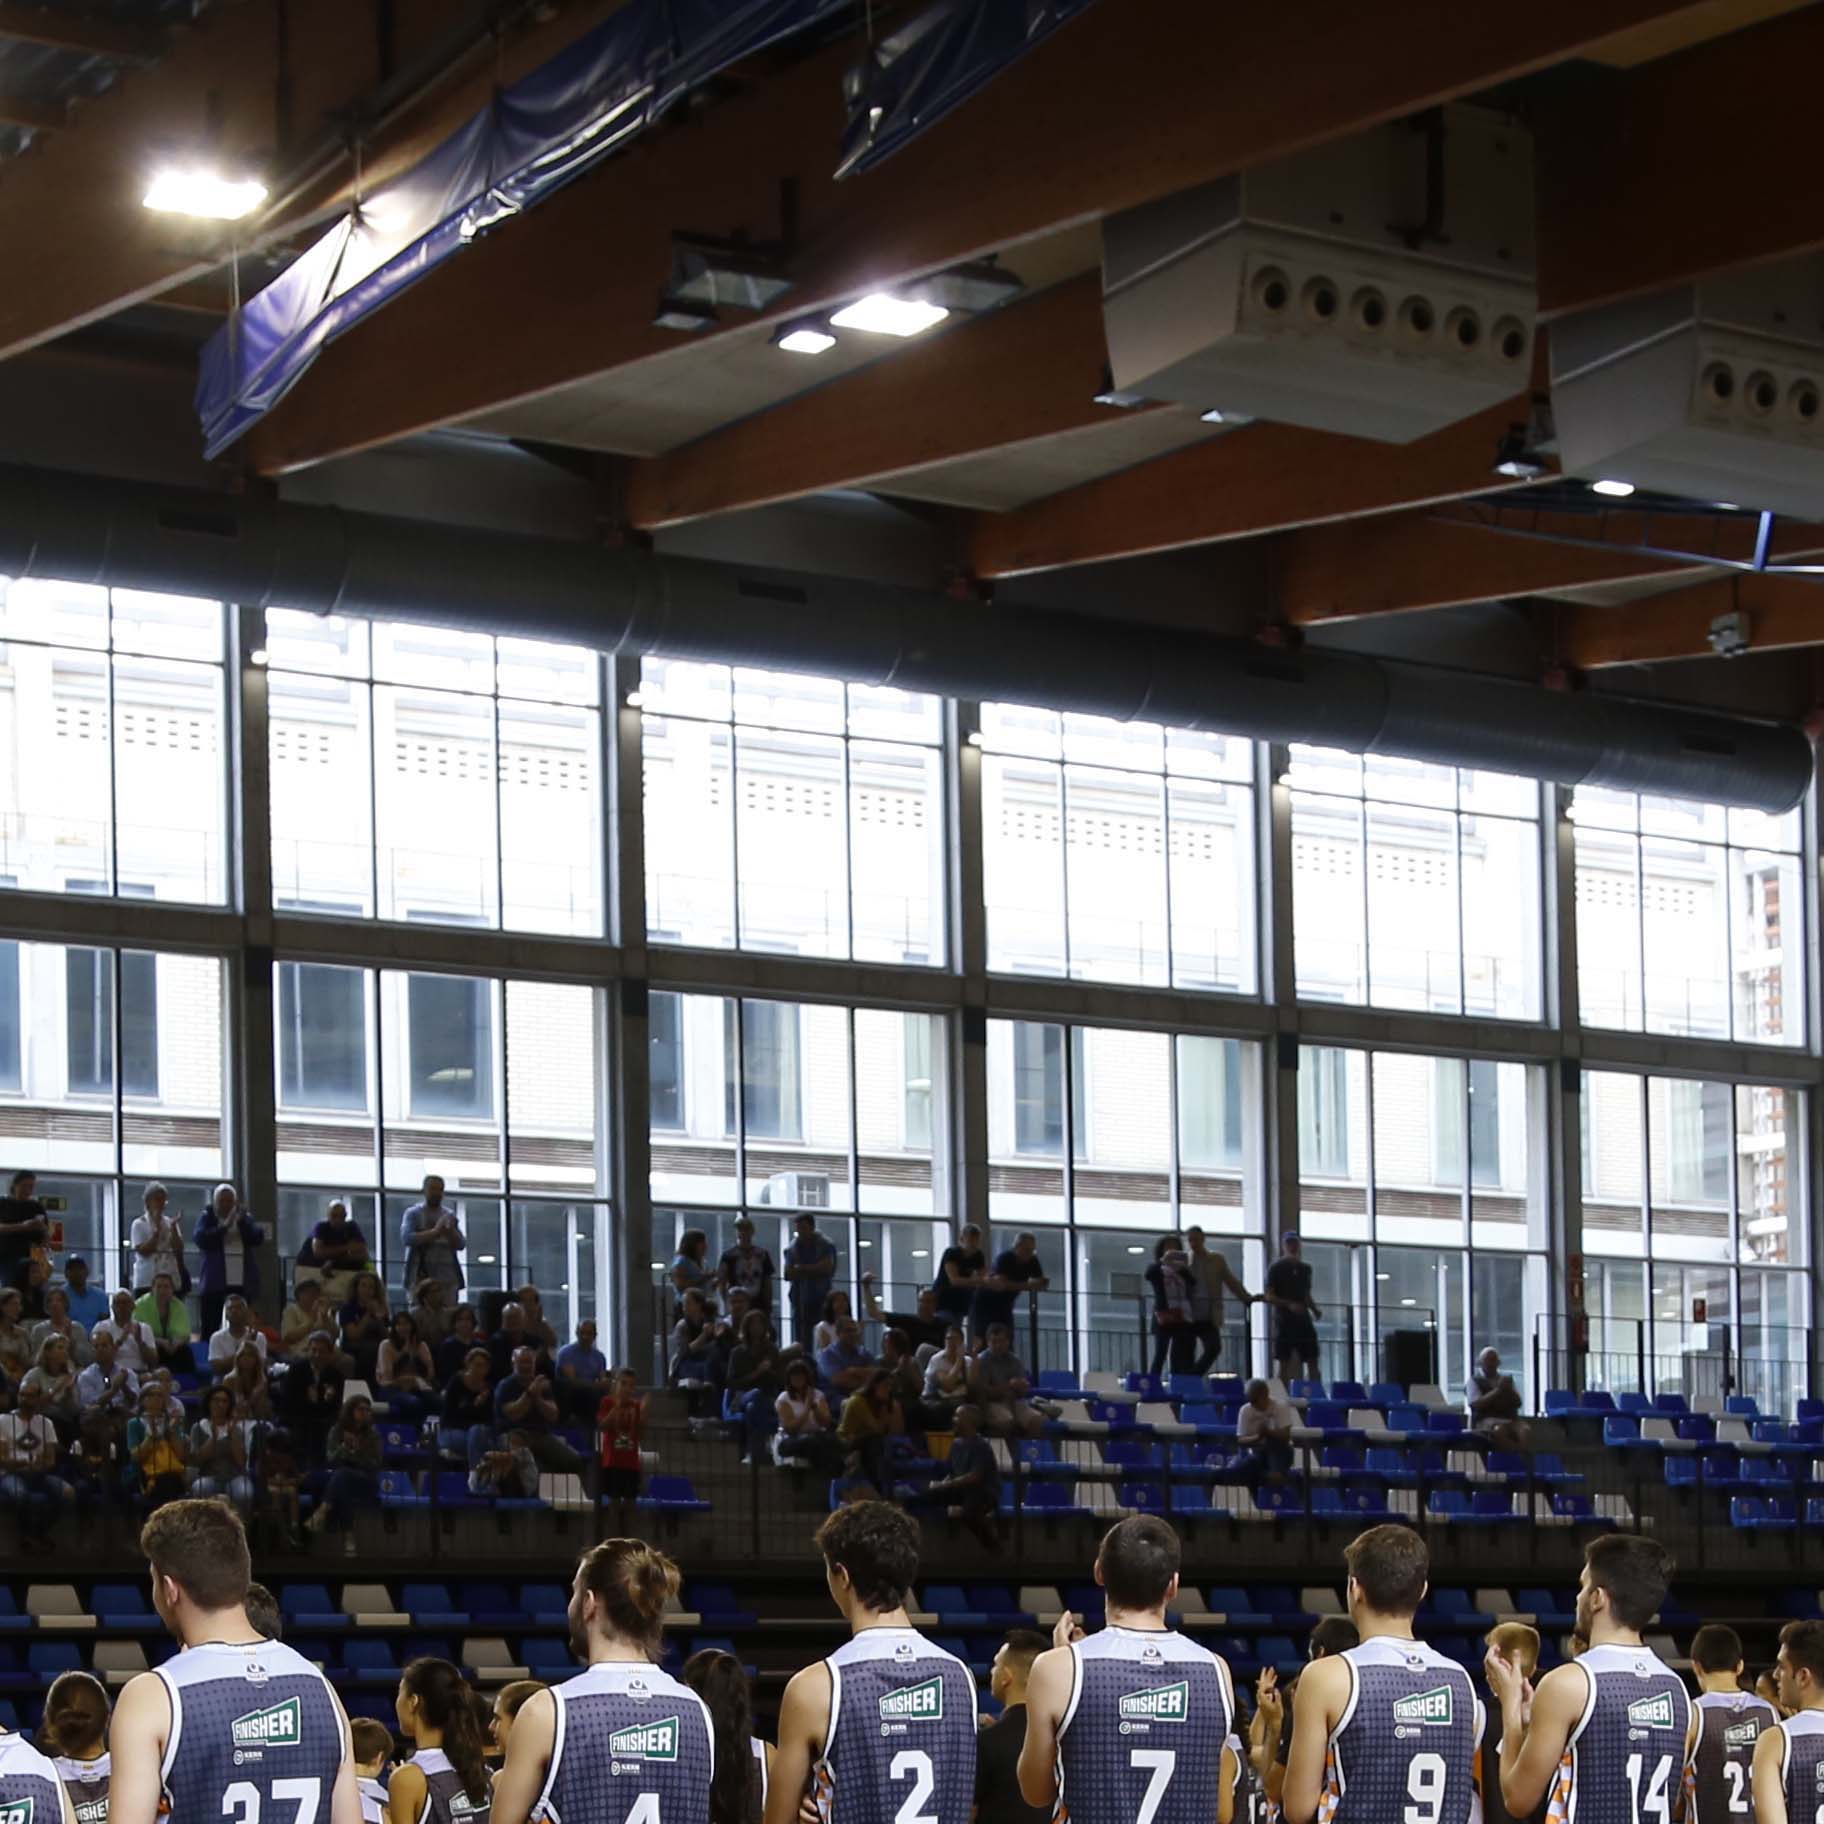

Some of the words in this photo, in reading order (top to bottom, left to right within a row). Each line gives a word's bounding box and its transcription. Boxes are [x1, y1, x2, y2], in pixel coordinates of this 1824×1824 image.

[882, 1687, 936, 1713] FINISHER
[1123, 1690, 1182, 1713] FINISHER
[1397, 1694, 1446, 1717] FINISHER
[235, 1709, 293, 1739] FINISHER
[613, 1727, 672, 1752] FINISHER
[1723, 1761, 1753, 1812] 2
